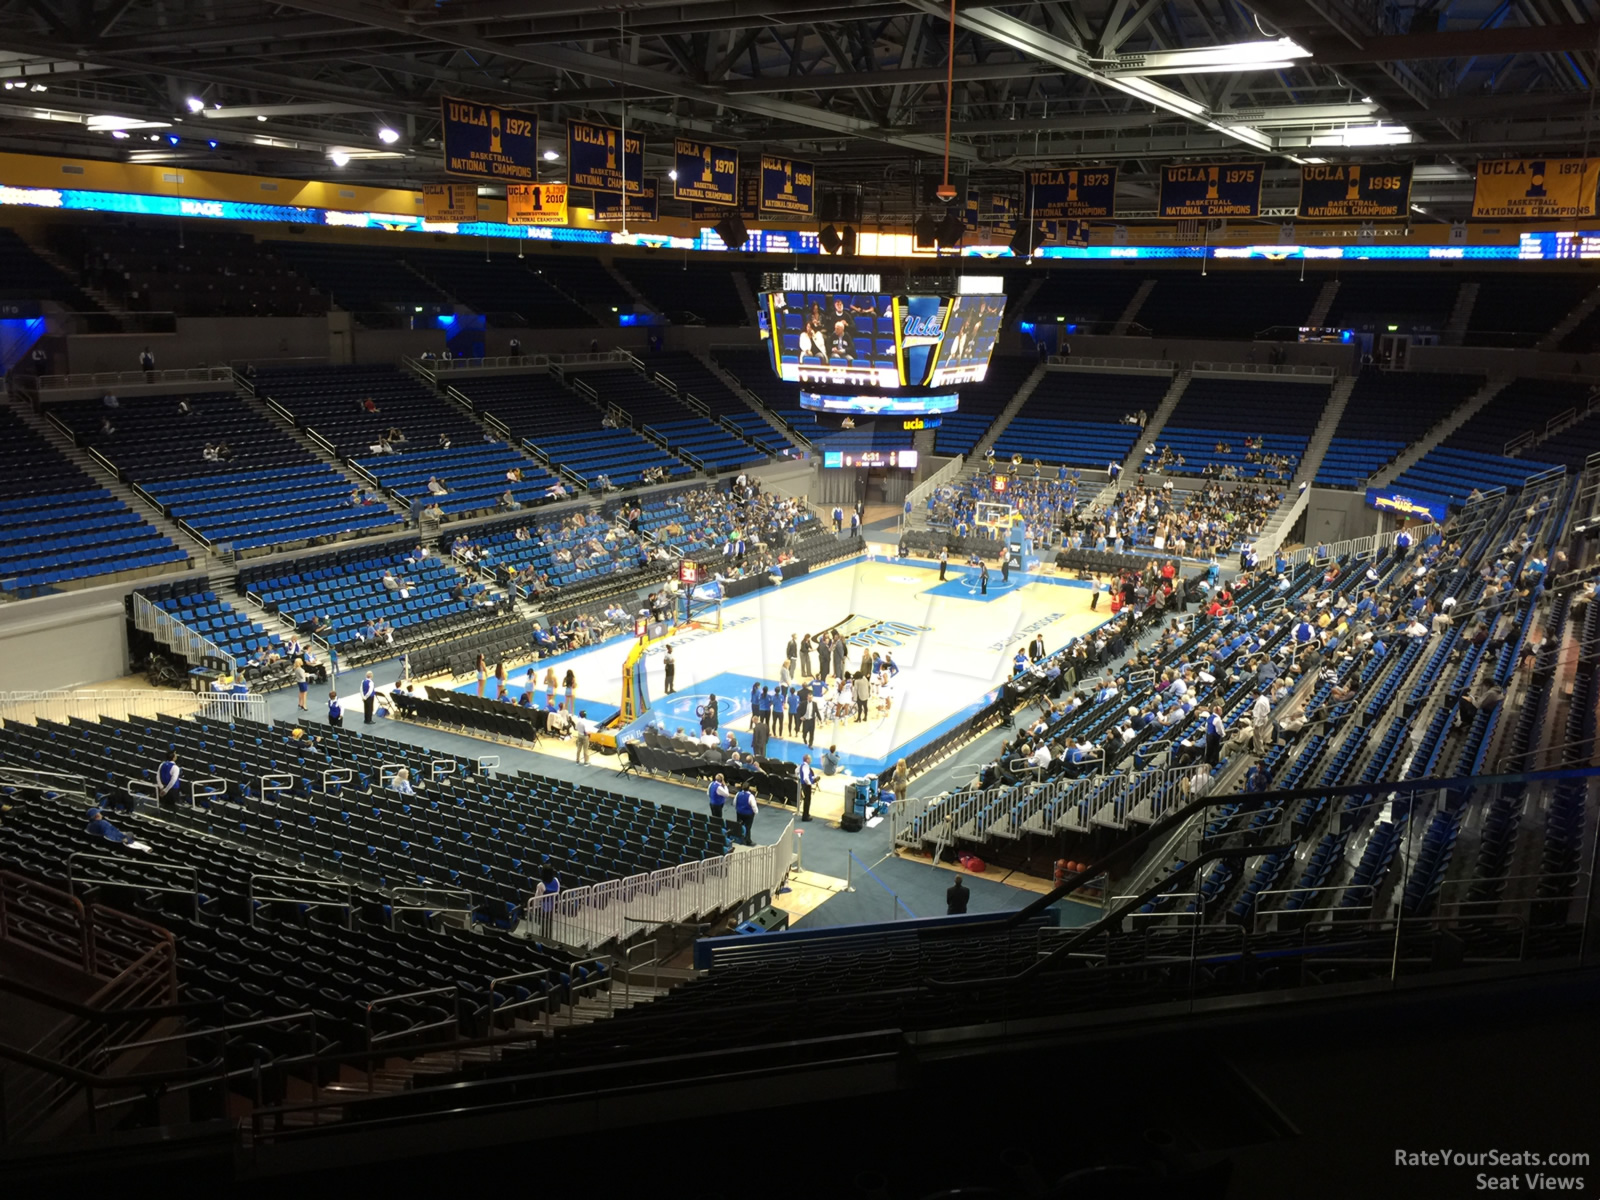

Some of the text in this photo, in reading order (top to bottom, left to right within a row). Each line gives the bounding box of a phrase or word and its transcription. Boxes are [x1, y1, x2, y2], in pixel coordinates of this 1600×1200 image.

[450, 104, 488, 127] UCLA
[506, 118, 531, 137] 1972
[574, 125, 605, 146] UCLA
[470, 151, 514, 164] BASKETBALL
[677, 142, 700, 157] UCLA
[715, 159, 735, 174] 1970
[452, 157, 532, 178] NATIONAL CHAMPIONS
[763, 157, 782, 171] UCLA
[794, 172, 812, 186] 1969
[1482, 162, 1526, 175] UCLA
[575, 174, 604, 187] NATIONAL
[1031, 172, 1065, 186] UCLA
[1084, 174, 1109, 186] 1973
[1168, 168, 1206, 182] UCLA
[1226, 170, 1254, 182] 1975
[1304, 167, 1344, 181] UCLA
[1368, 176, 1401, 190] 1995
[508, 187, 529, 196] UCLA
[694, 181, 718, 191] BASKETBALL
[546, 195, 564, 204] 2010
[678, 188, 732, 202] NATIONAL CHAMPIONS
[777, 193, 798, 202] BASKETBALL
[765, 200, 808, 212] NATIONAL CHAMPIONS
[1031, 208, 1106, 216] NATIONAL CHAMPIONS
[1166, 206, 1250, 215] NATIONAL CHAMPIONS
[1308, 206, 1398, 216] NATIONAL CHAMPIONS
[1532, 206, 1590, 215] CHAMPIONS
[783, 273, 880, 292] EDWIN W PAULEY PAVILION
[994, 481, 1004, 490] 30
[682, 568, 695, 580] 30
